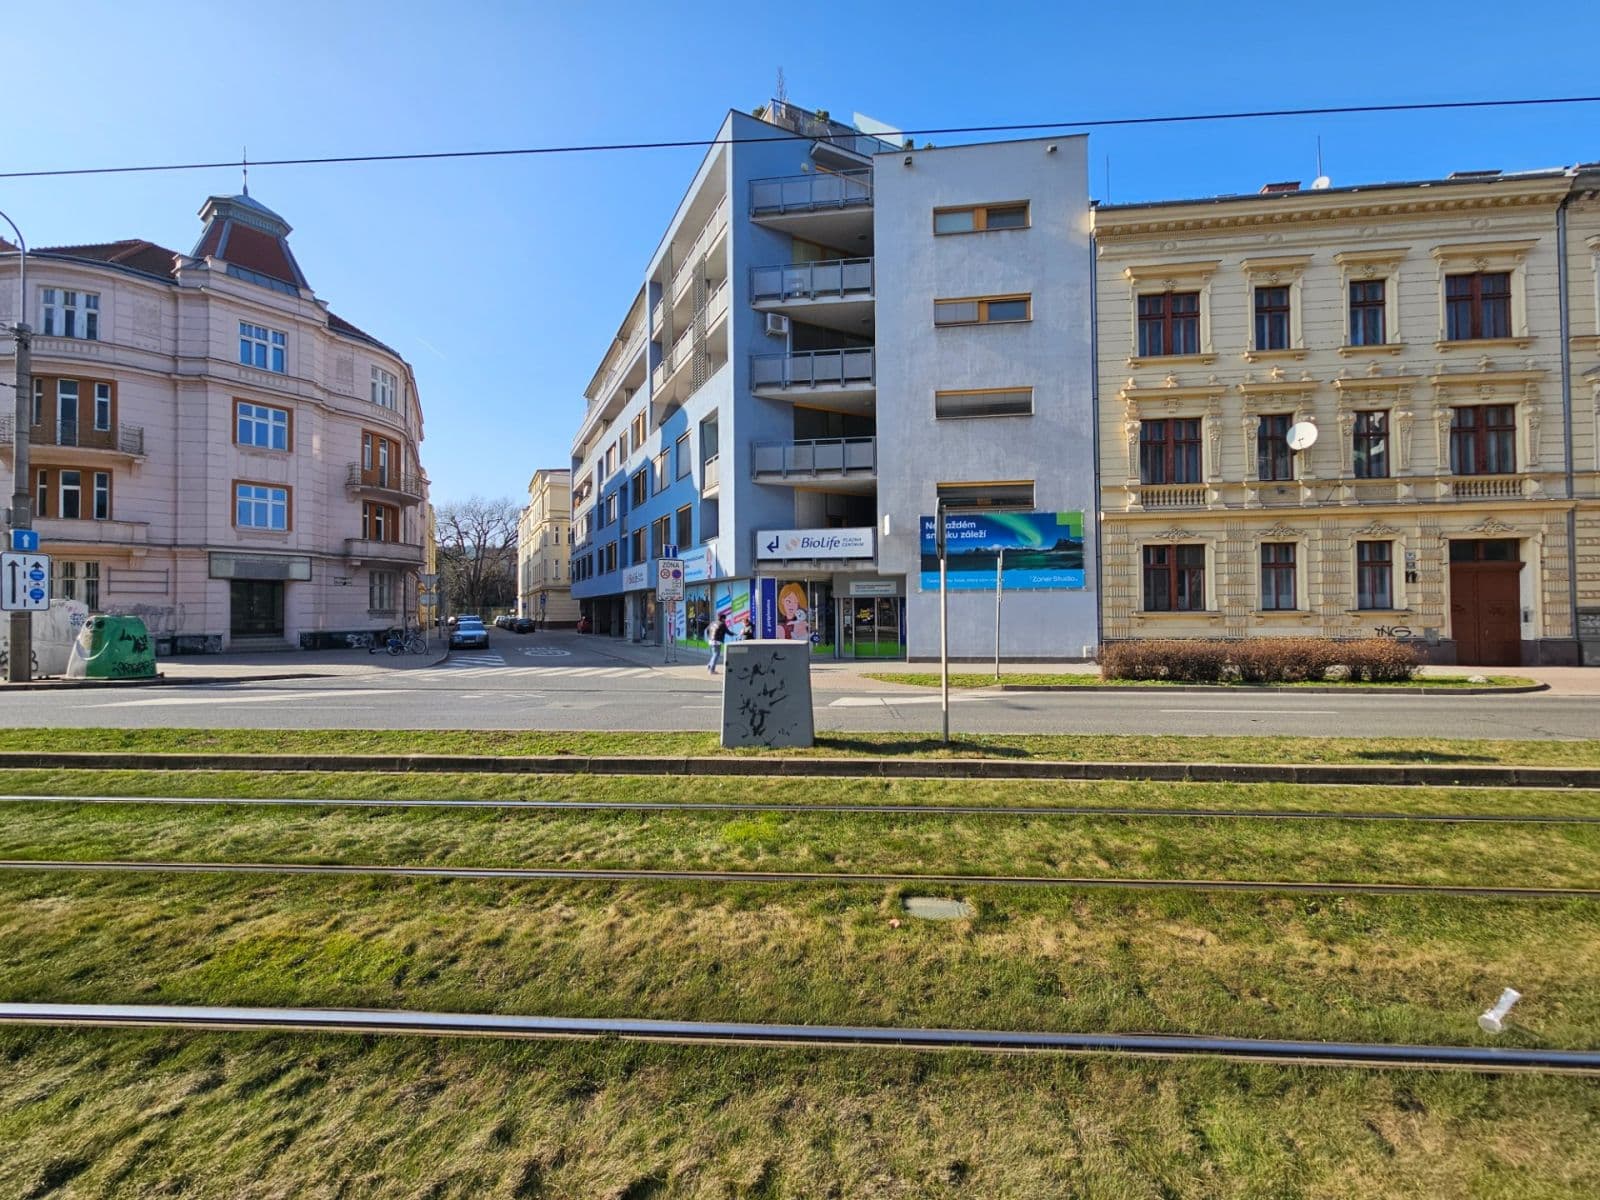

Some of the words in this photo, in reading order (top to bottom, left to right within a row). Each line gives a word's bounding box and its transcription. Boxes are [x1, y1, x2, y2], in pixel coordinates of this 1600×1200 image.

[944, 520, 976, 529] aždém
[925, 530, 959, 539] snku
[960, 529, 987, 539] záleží
[801, 535, 841, 550] BioLife
